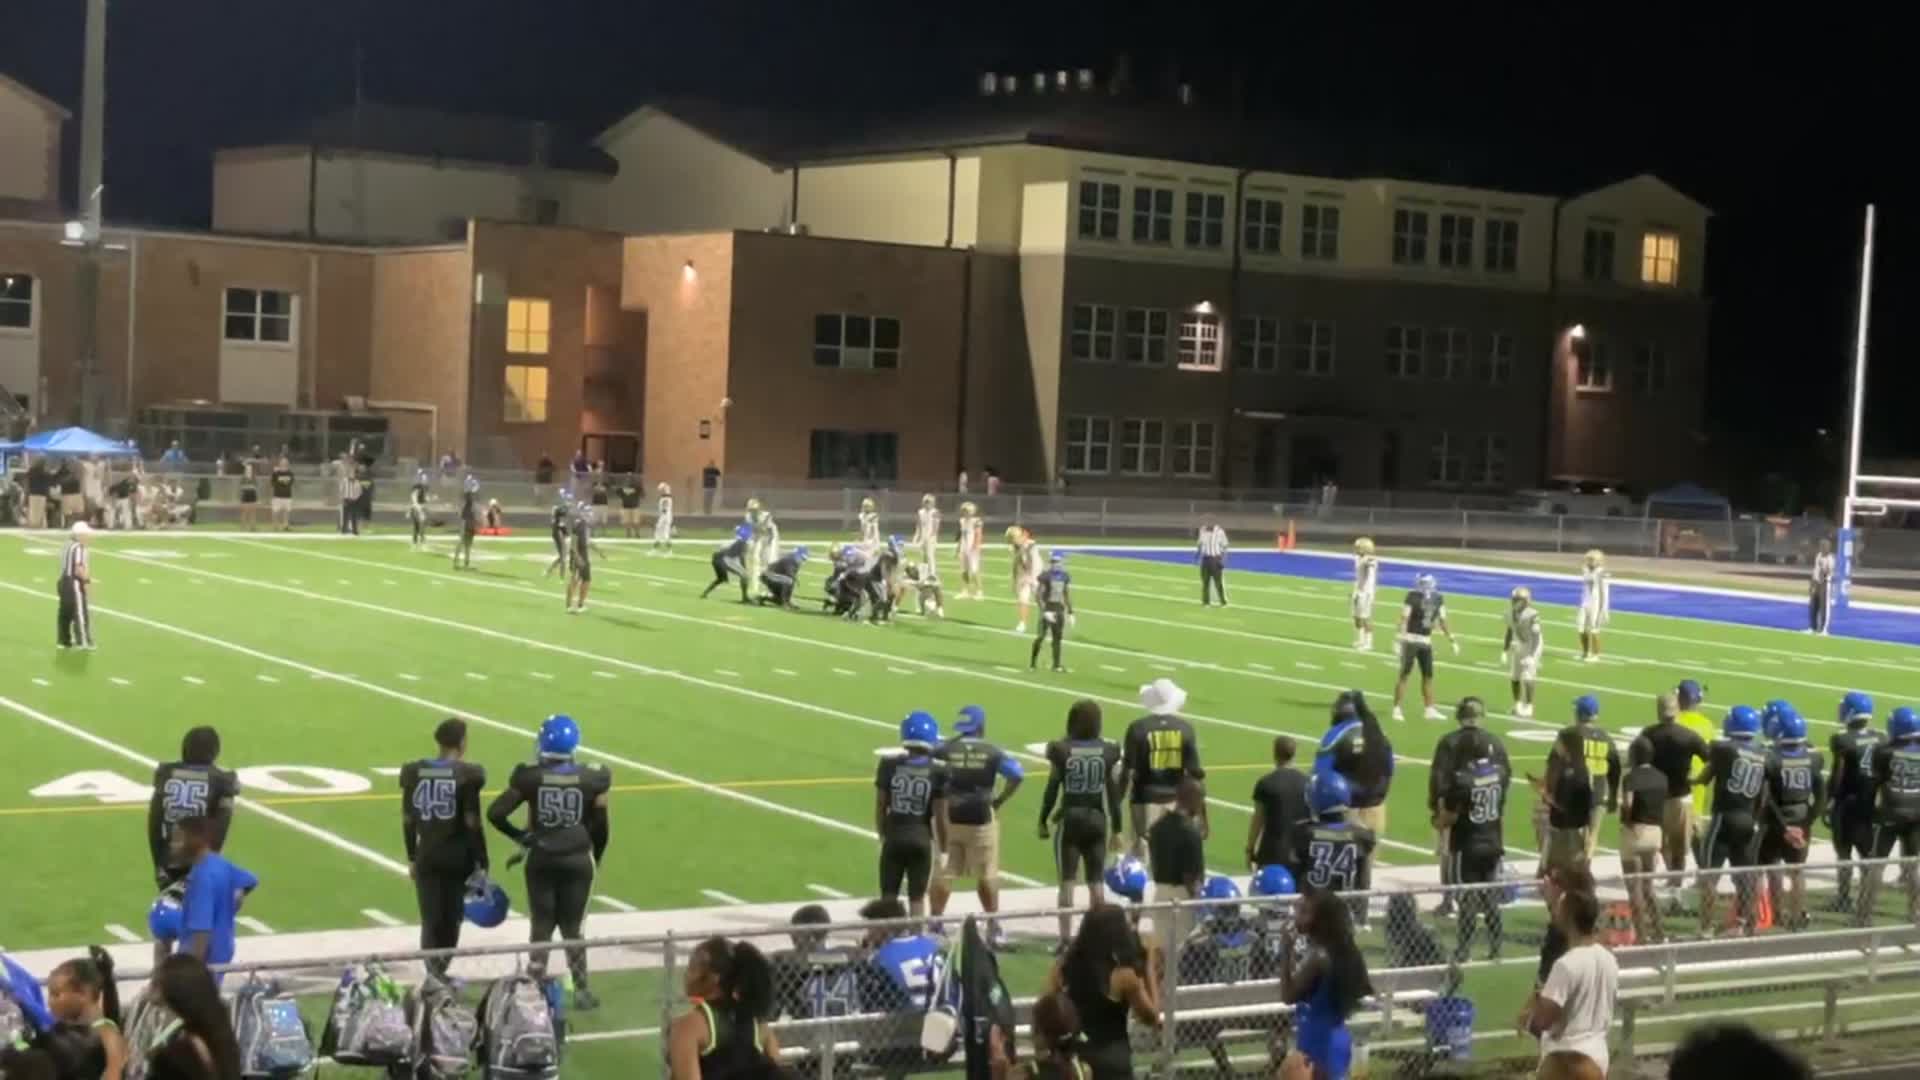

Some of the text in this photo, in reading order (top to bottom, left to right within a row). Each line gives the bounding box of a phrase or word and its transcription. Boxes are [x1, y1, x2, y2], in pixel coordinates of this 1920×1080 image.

[1065, 755, 1105, 794] 20
[163, 778, 208, 823] 25
[413, 779, 457, 820] 45
[537, 786, 583, 827] 59
[890, 775, 932, 816] 29
[1307, 841, 1357, 891] 34
